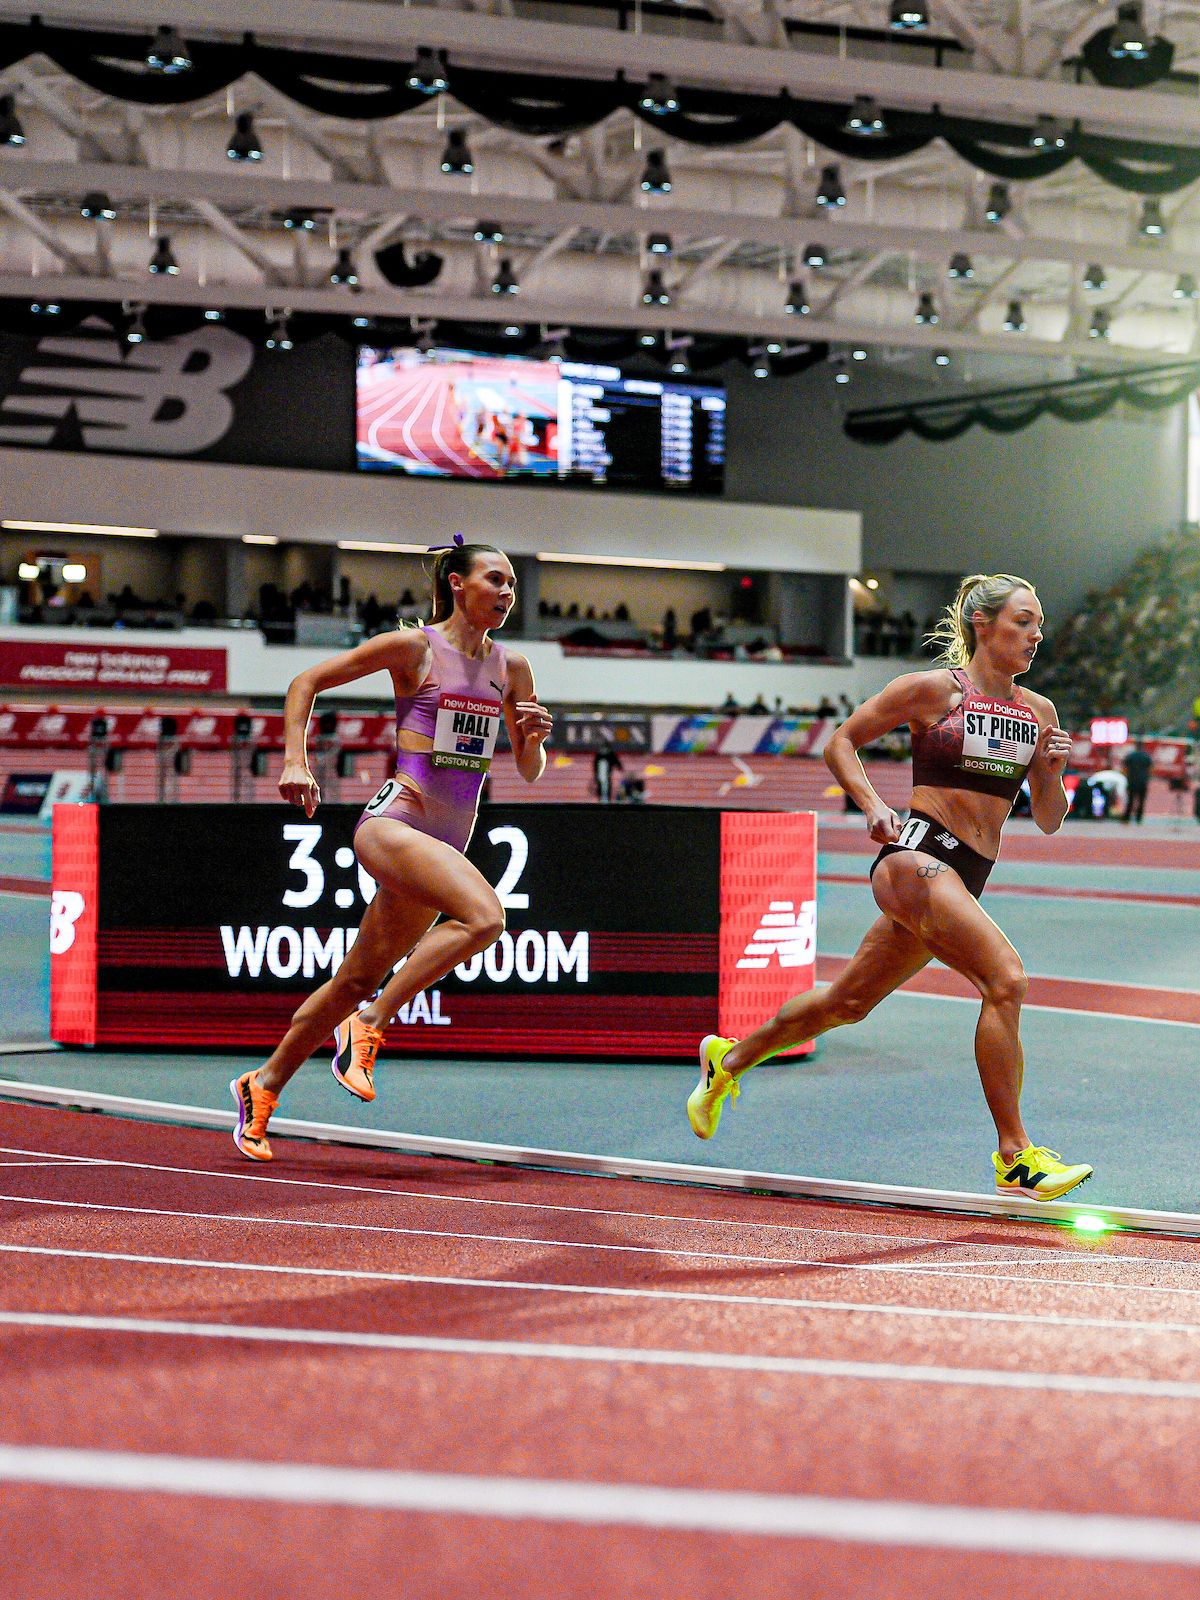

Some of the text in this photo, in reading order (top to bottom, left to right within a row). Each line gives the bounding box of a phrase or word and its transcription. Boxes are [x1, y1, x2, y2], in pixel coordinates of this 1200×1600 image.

[444, 699, 466, 709] new
[969, 701, 1032, 720] new balance
[453, 712, 490, 737] HALL
[966, 713, 1037, 746] ST. PIERRE
[435, 755, 480, 768] BOSTON 26
[964, 760, 1004, 773] BOSTON
[367, 781, 393, 810] 9
[357, 988, 452, 1025] NAL
